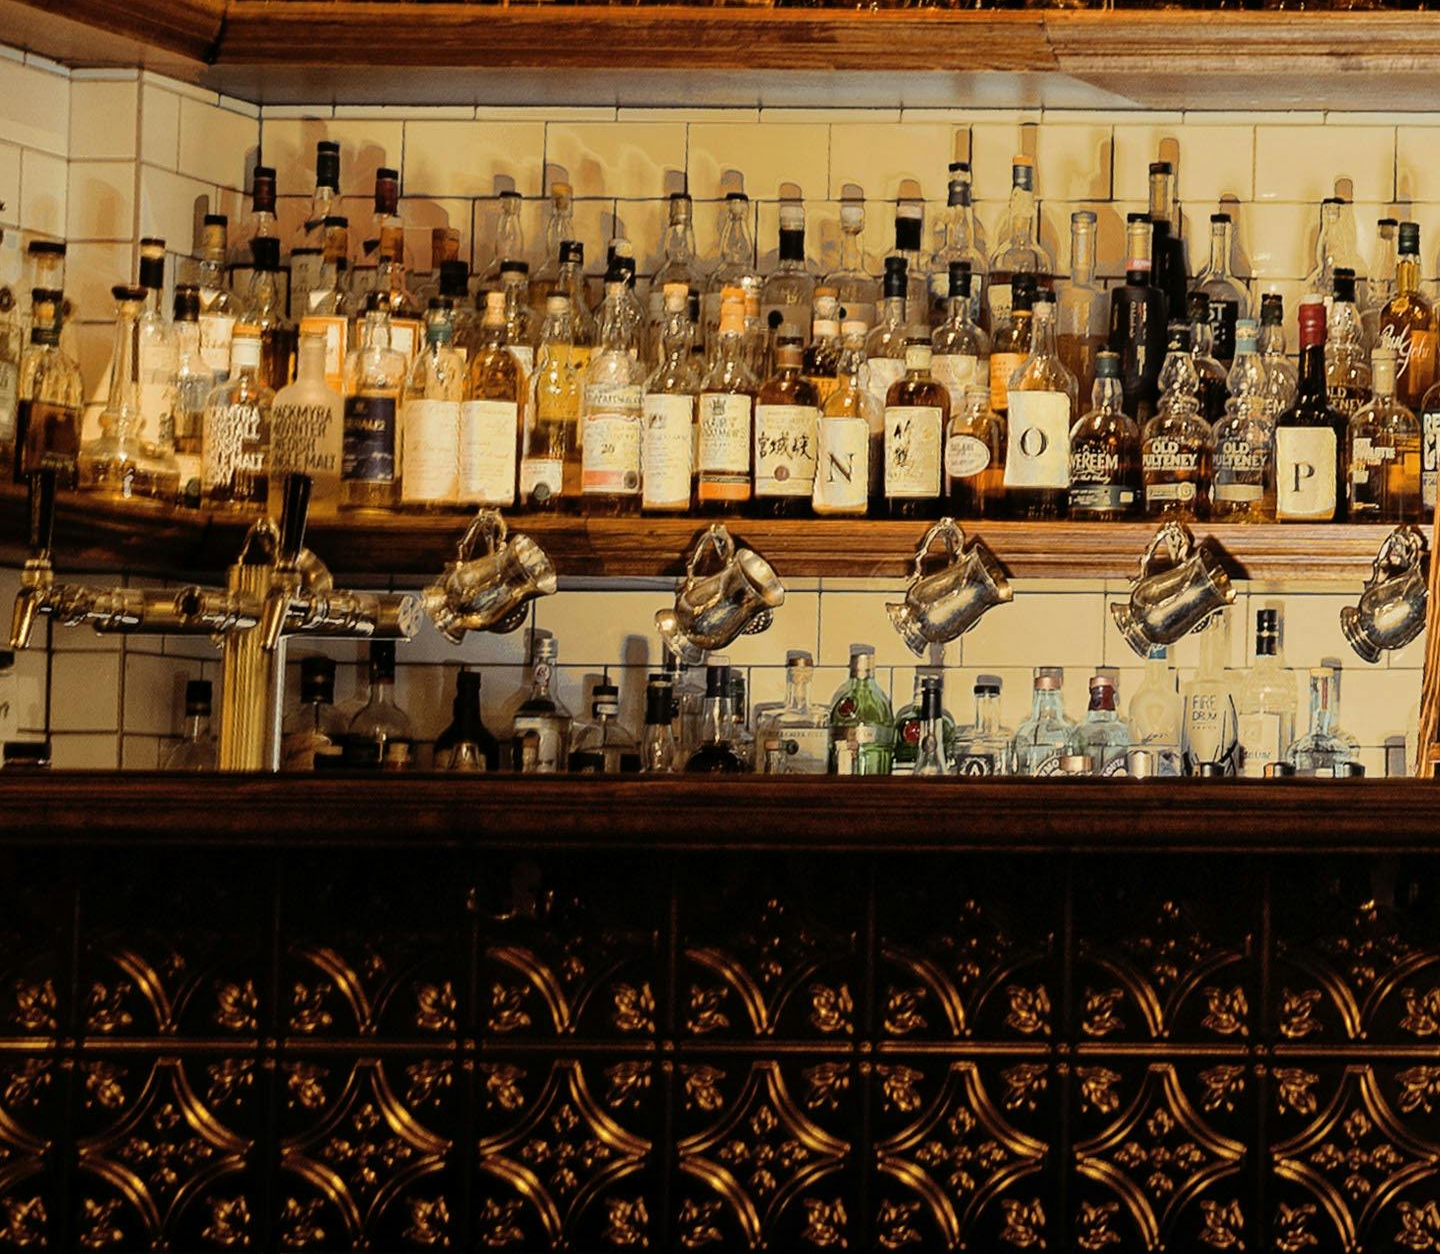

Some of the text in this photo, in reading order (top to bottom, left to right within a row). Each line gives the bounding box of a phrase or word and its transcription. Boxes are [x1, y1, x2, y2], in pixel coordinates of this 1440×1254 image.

[1019, 425, 1047, 458] O
[1151, 441, 1180, 455] OLD
[1222, 442, 1250, 456] OLD
[827, 452, 855, 483] N
[1071, 453, 1119, 471] VEREEM
[1290, 463, 1316, 493] P
